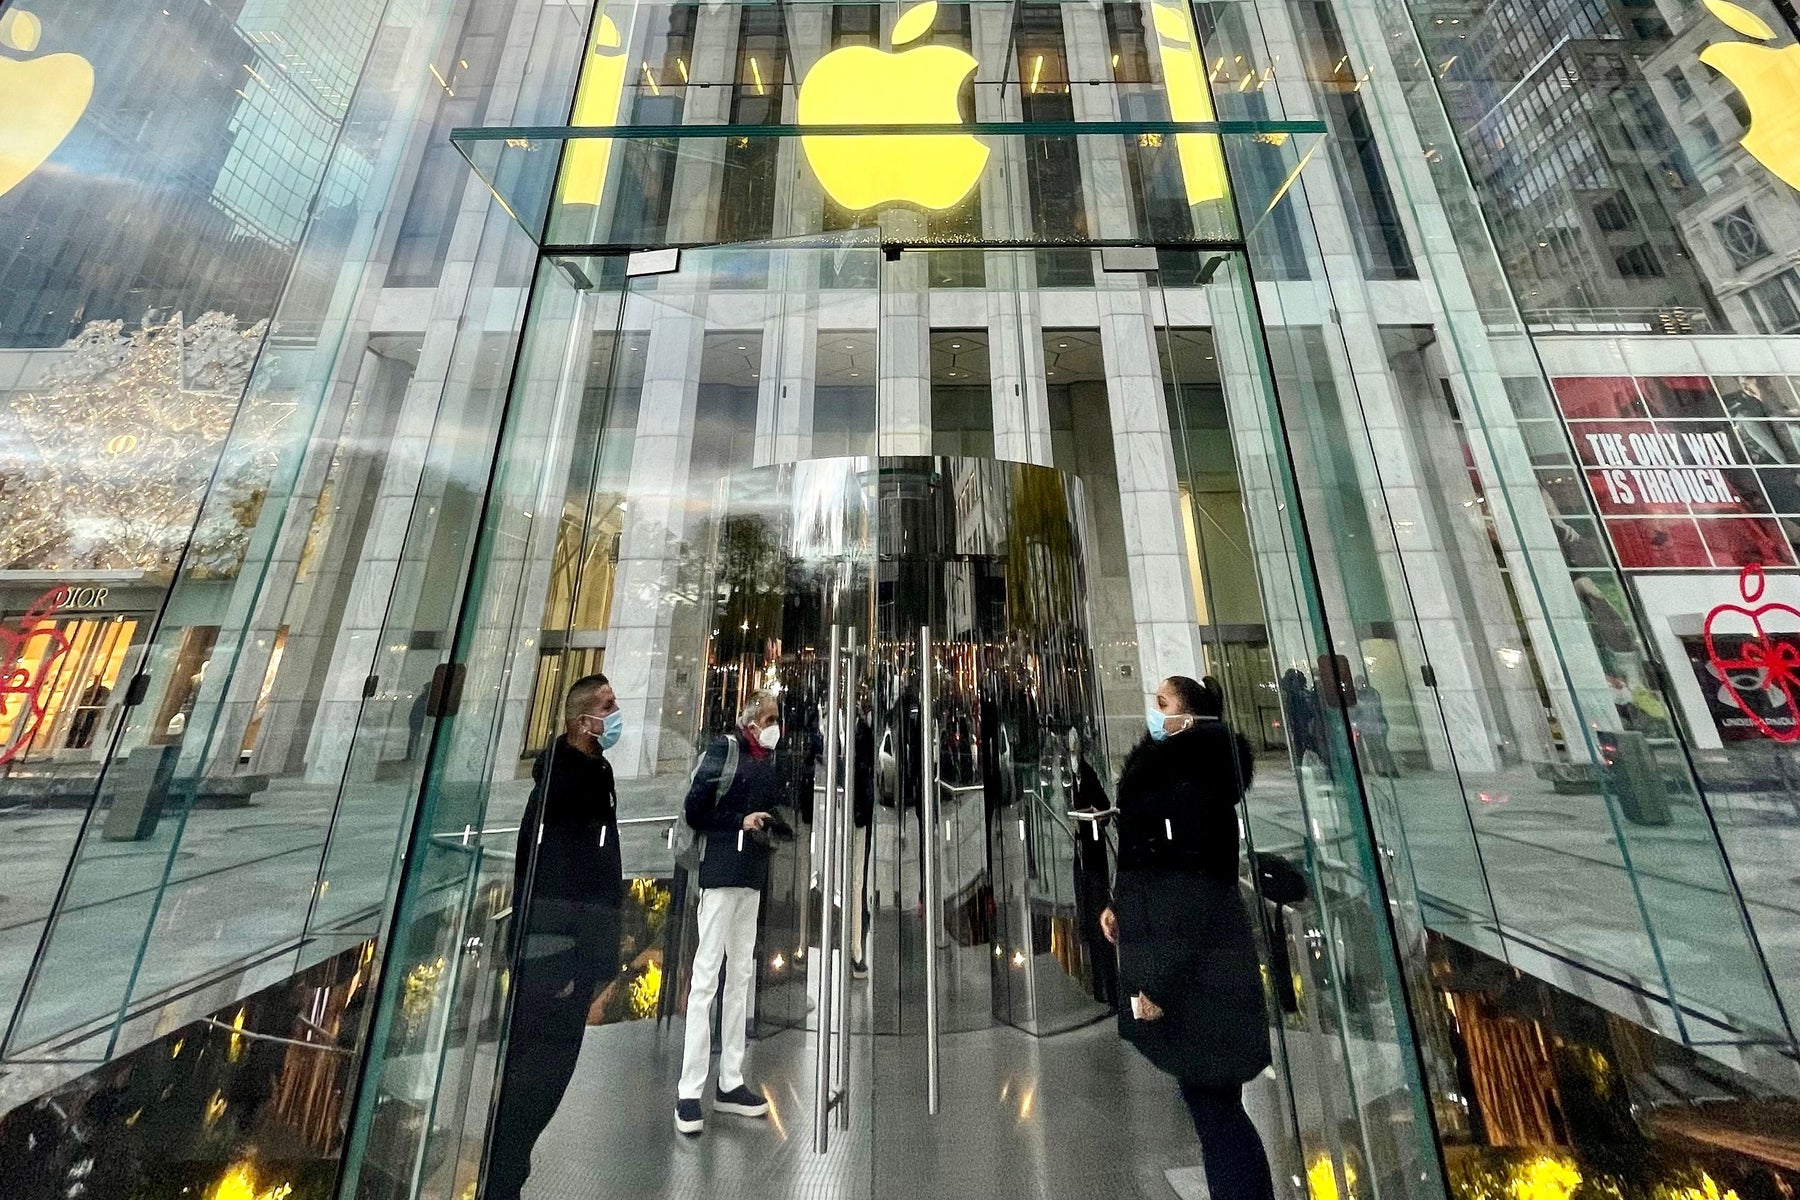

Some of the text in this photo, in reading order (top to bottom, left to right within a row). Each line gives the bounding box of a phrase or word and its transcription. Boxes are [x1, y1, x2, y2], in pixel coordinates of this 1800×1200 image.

[1585, 432, 1737, 466] THE ONLY WAY
[1601, 469, 1741, 504] IS THROUGH.
[52, 586, 108, 608] DIOR
[1757, 716, 1799, 726] RMOU
